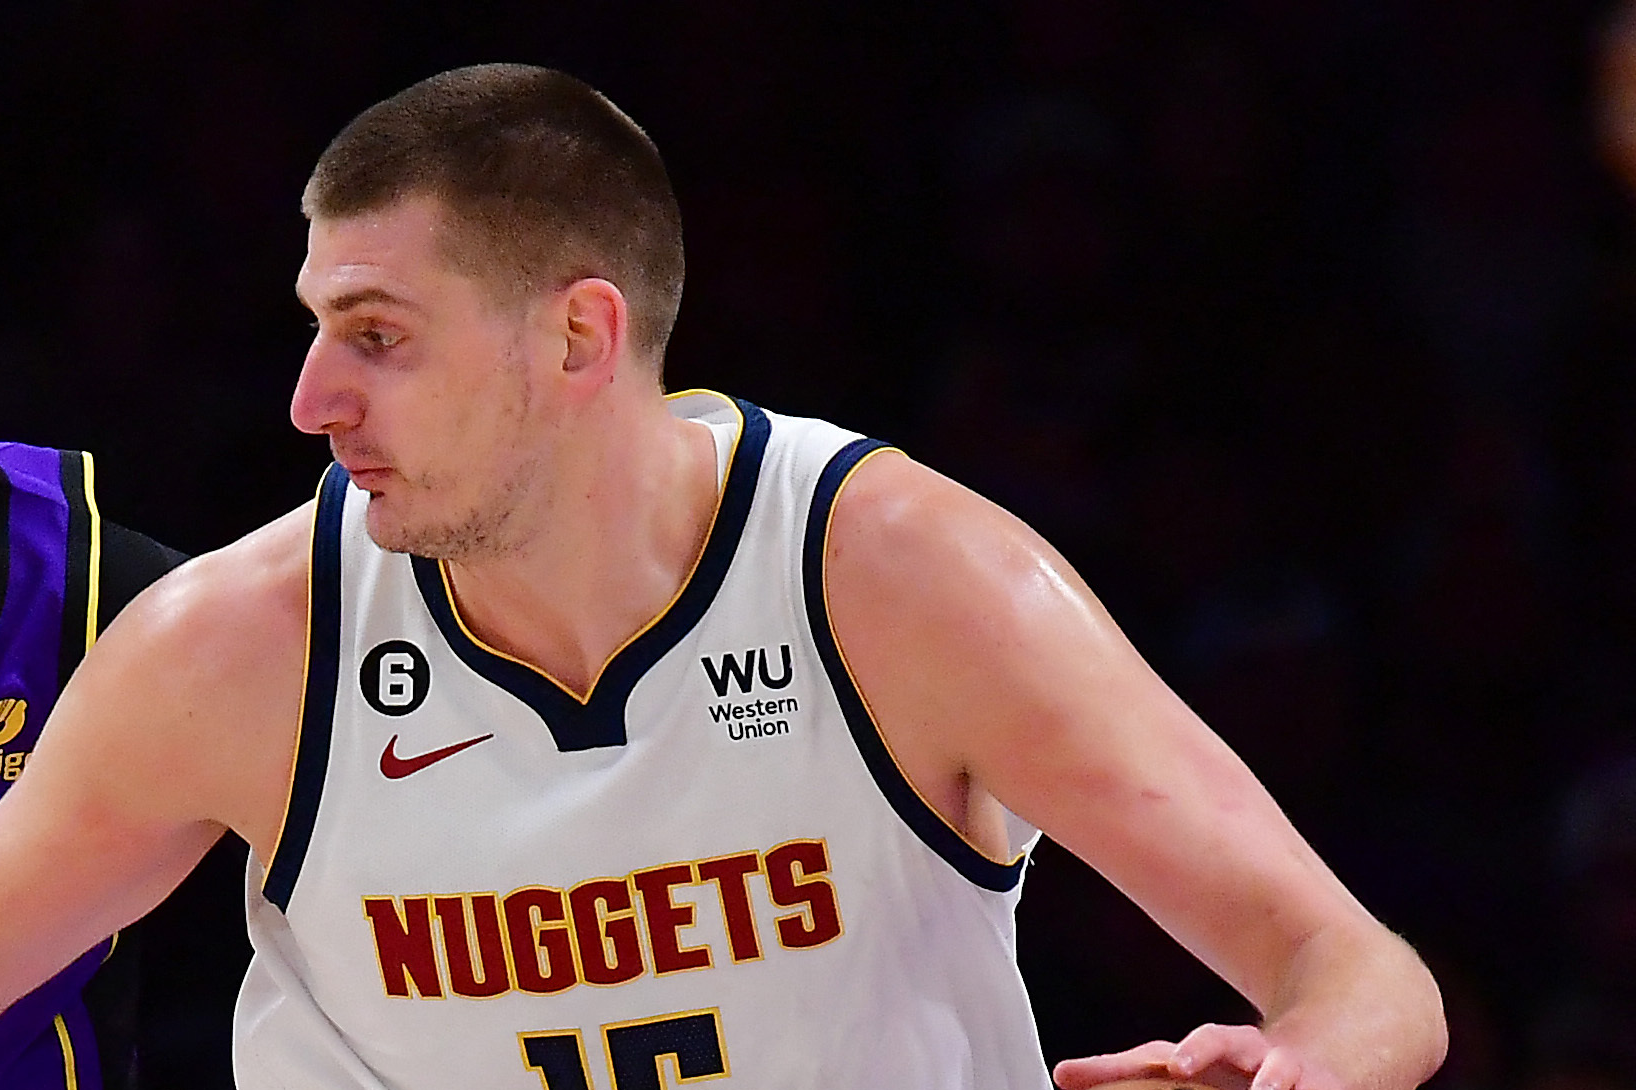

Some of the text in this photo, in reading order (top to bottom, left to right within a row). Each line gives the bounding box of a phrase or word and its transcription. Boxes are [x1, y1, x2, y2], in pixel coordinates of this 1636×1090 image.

[377, 652, 415, 707] 6
[700, 644, 793, 698] WU
[708, 698, 798, 723] Western
[727, 718, 789, 741] Union
[362, 837, 845, 1001] NUGGETS
